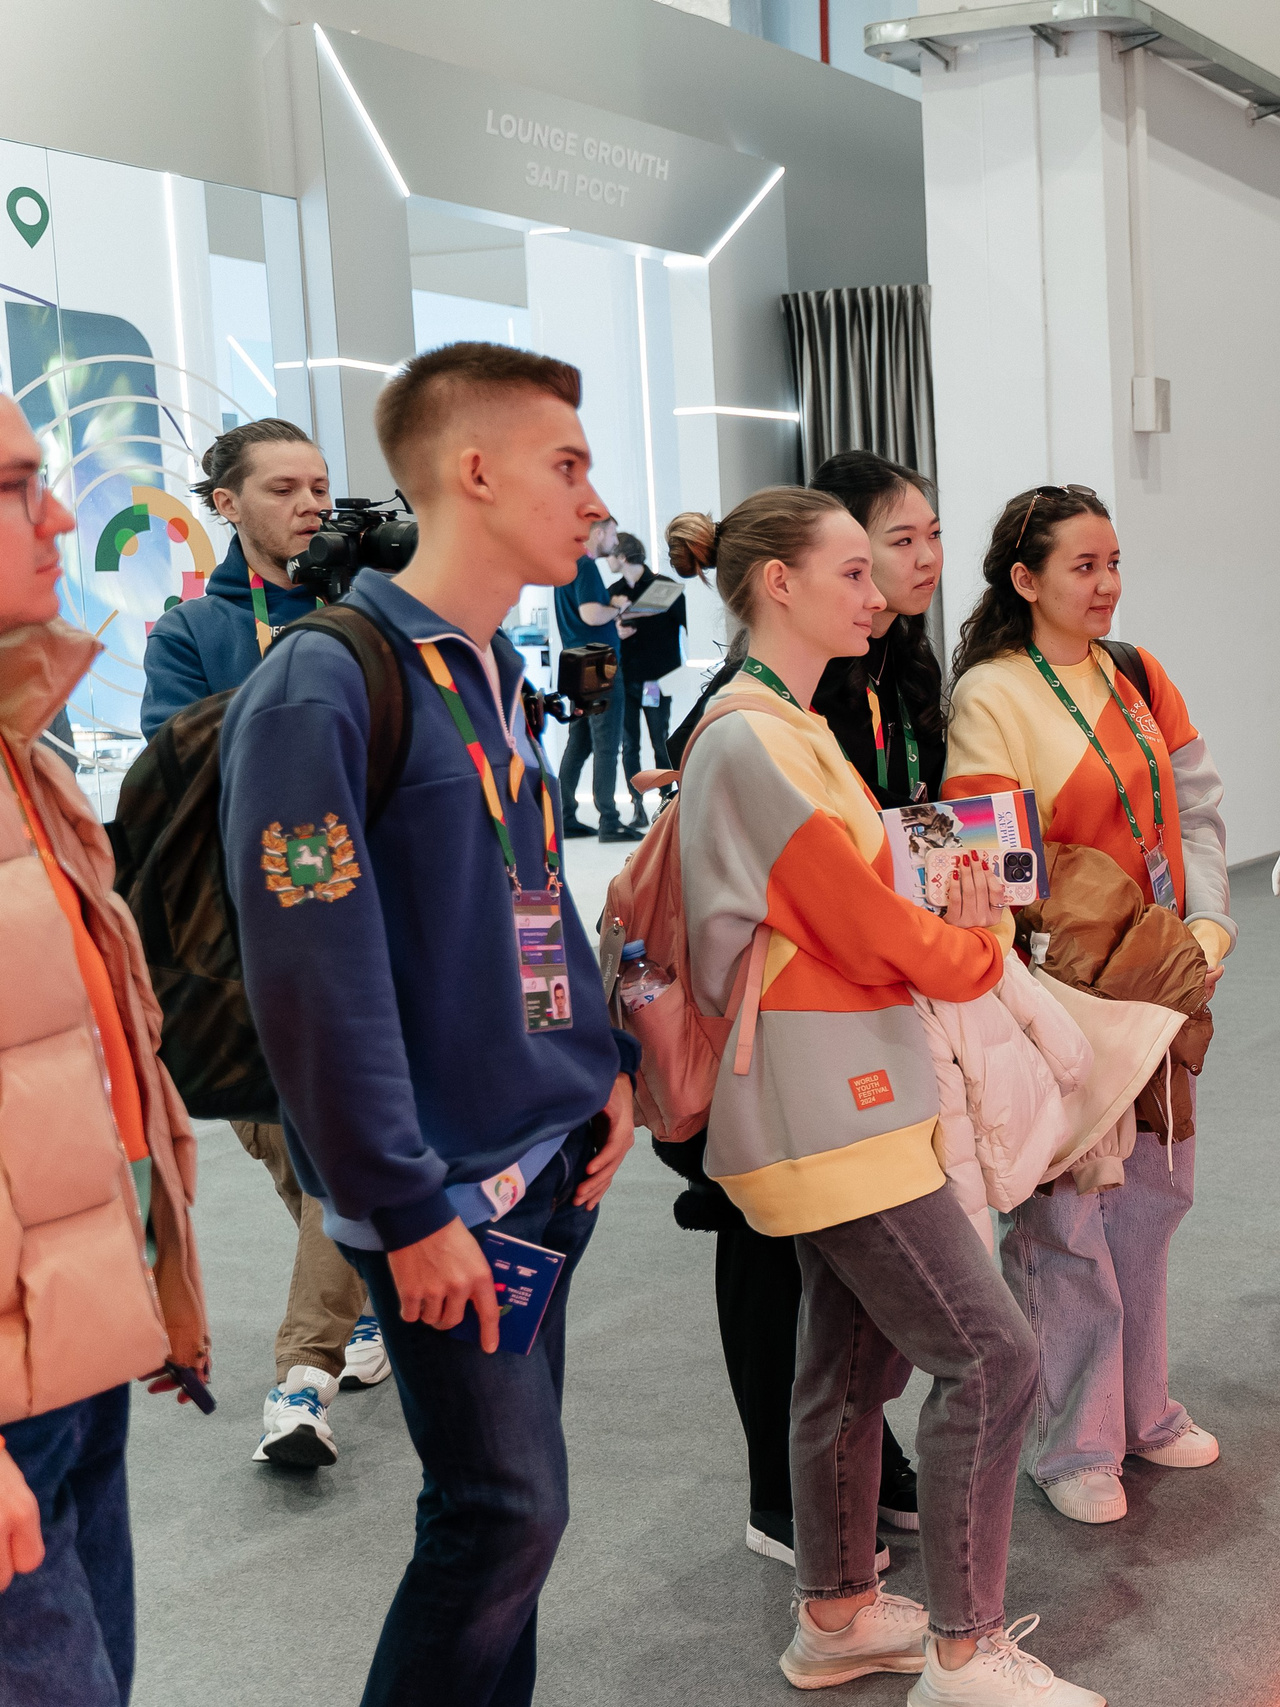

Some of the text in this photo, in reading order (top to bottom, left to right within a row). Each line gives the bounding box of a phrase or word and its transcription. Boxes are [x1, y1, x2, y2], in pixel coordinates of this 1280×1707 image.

[486, 109, 670, 181] LOUNGE GROWTH
[525, 162, 630, 207] ЗАЛ РОСТ
[854, 1074, 879, 1087] WORLD
[856, 1081, 880, 1093] YOUTH
[858, 1086, 890, 1099] FESTIVAL
[860, 1096, 876, 1106] 2024
